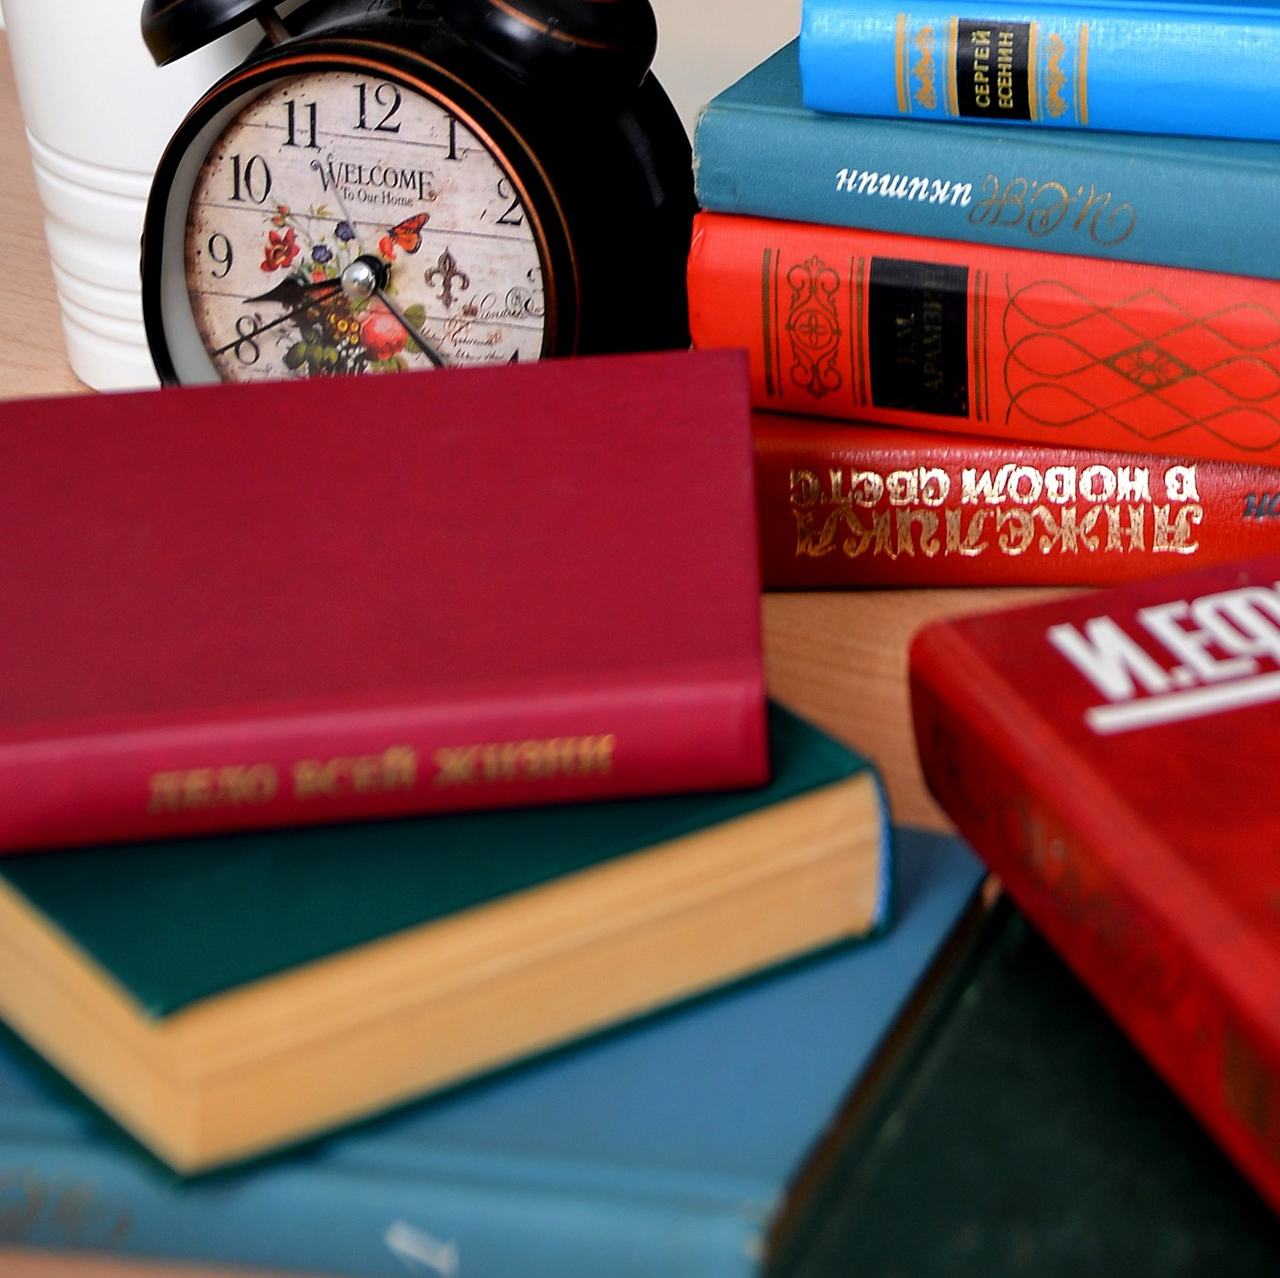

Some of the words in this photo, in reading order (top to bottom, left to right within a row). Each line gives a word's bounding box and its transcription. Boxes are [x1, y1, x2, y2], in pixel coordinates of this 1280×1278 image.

[971, 28, 992, 108] СЕРГЕЙ
[997, 31, 1014, 110] ЕСЕНИН
[283, 100, 321, 149] 11
[353, 82, 402, 133] 12
[444, 114, 461, 161] 1
[229, 154, 272, 204] 10
[310, 153, 437, 201] WELCOME
[341, 187, 354, 201] To
[358, 188, 378, 203] Our
[382, 191, 413, 207] Home
[207, 233, 233, 279] 9
[234, 314, 260, 365] 8
[149, 764, 278, 816] ДЕЛО
[292, 745, 416, 800] ВСЕЙ
[433, 734, 614, 789] ЖИЗНИ
